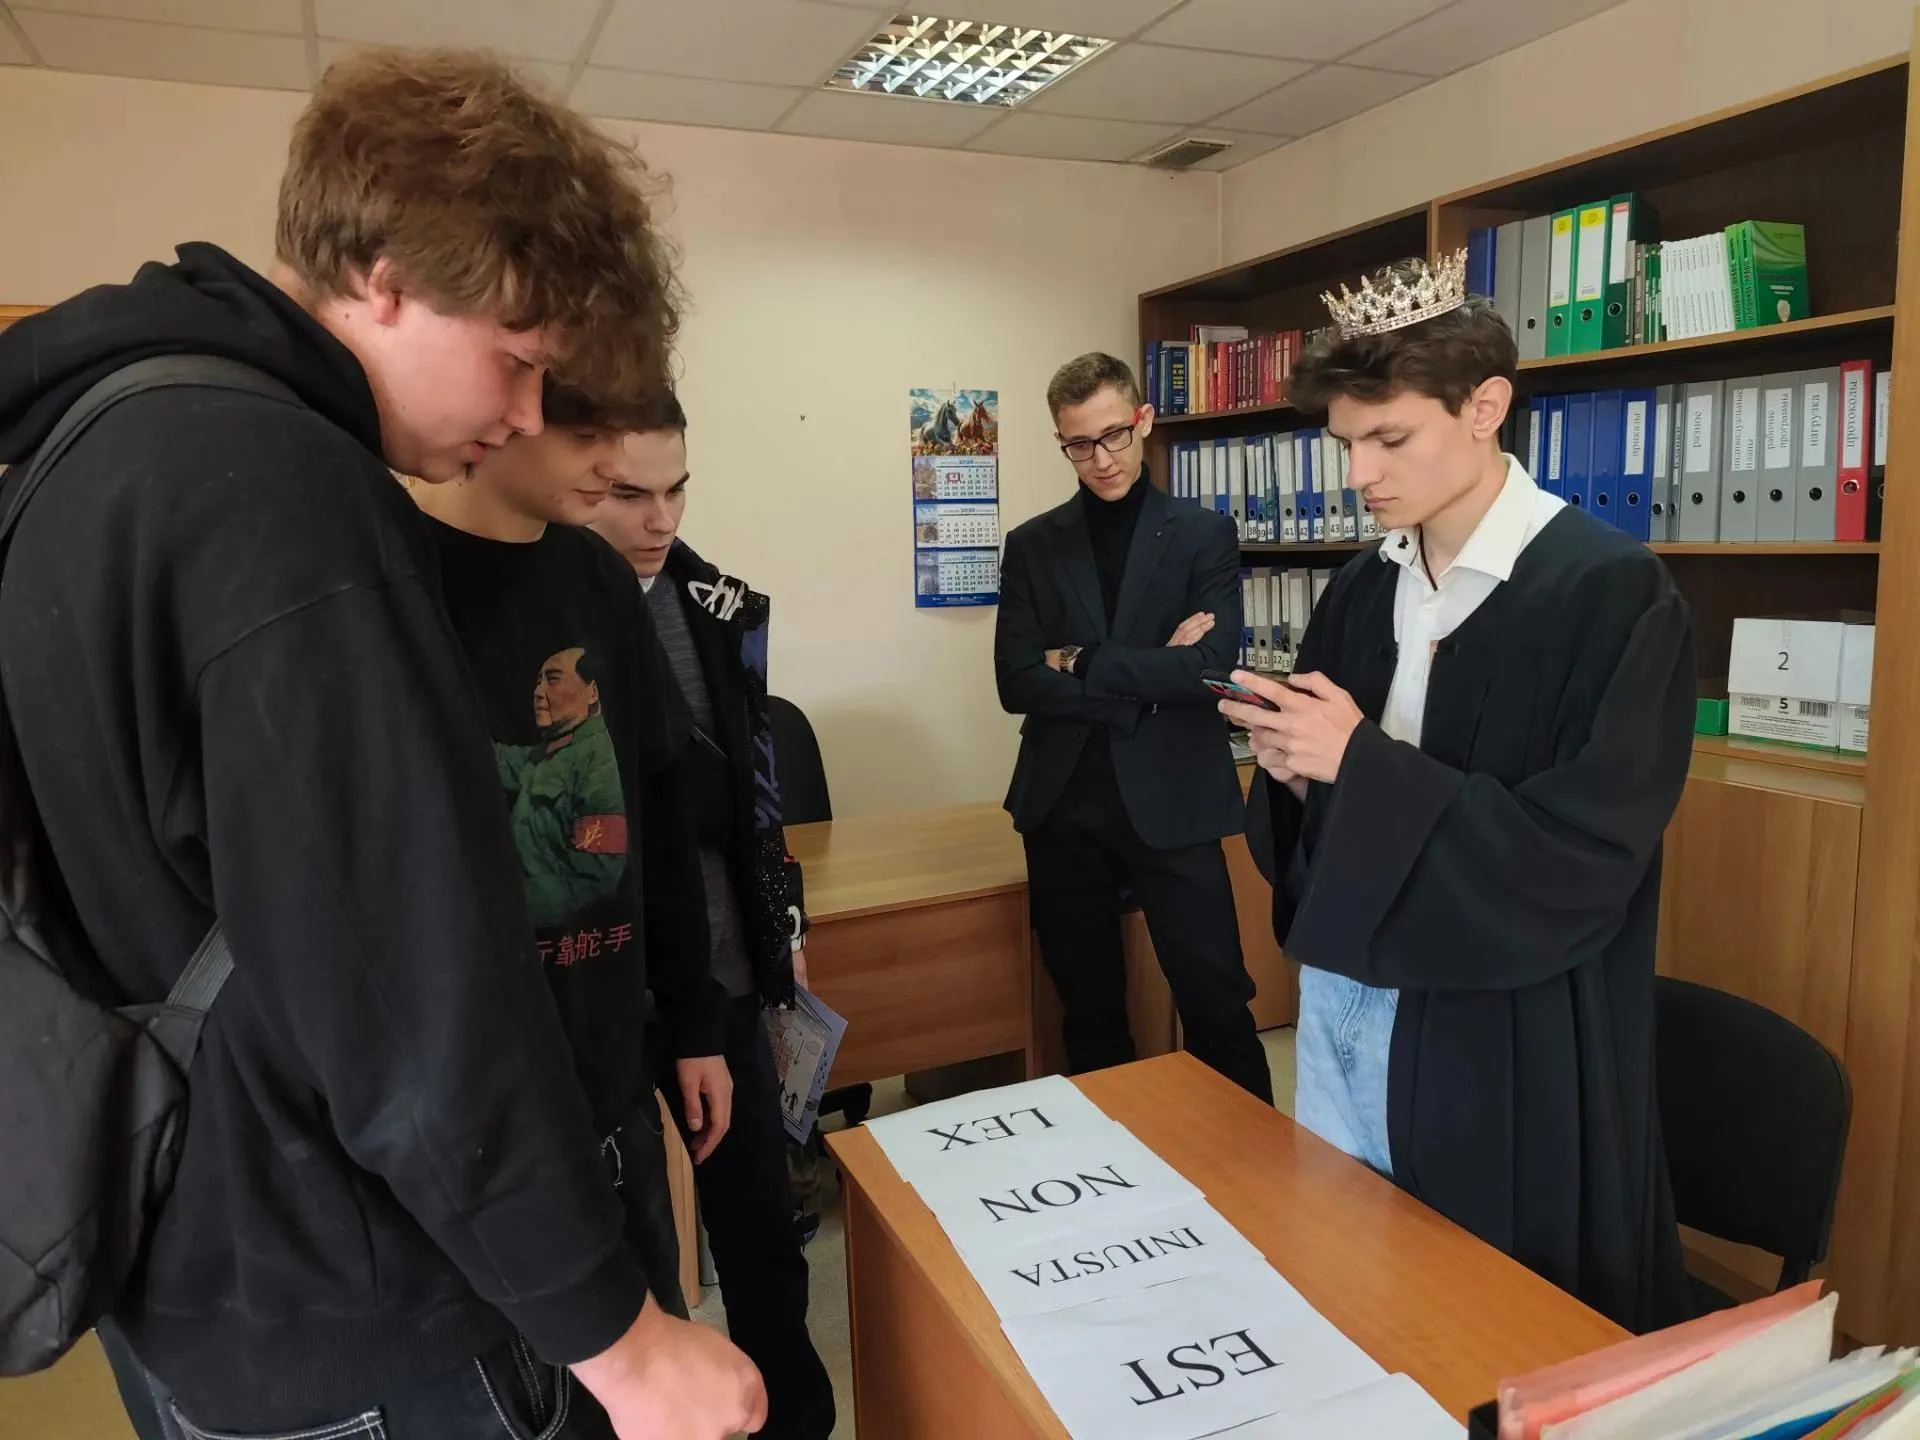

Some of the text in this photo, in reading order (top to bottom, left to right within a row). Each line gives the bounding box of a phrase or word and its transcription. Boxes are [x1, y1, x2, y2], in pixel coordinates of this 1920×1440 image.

[1779, 392, 1790, 448] программы
[1809, 394, 1821, 447] нагрузка
[1846, 381, 1859, 448] протоколы
[1632, 413, 1642, 457] приказы
[1692, 411, 1702, 448] разное
[1766, 409, 1776, 449] рабочие
[1248, 526, 1257, 536] 38
[1284, 527, 1294, 536] 41
[1299, 527, 1308, 536] 42
[1314, 526, 1323, 535] 43
[1330, 524, 1340, 533] 43
[1344, 525, 1354, 534] 44
[1363, 524, 1375, 534] 45
[1247, 653, 1256, 662] 10
[1258, 656, 1268, 664] 11
[1273, 655, 1282, 664] 12
[1777, 651, 1789, 671] 2
[924, 1106, 1059, 1151] LEX
[978, 1165, 1141, 1223] NON
[1010, 1227, 1207, 1287] INIUSTA
[1120, 1328, 1285, 1406] EST
